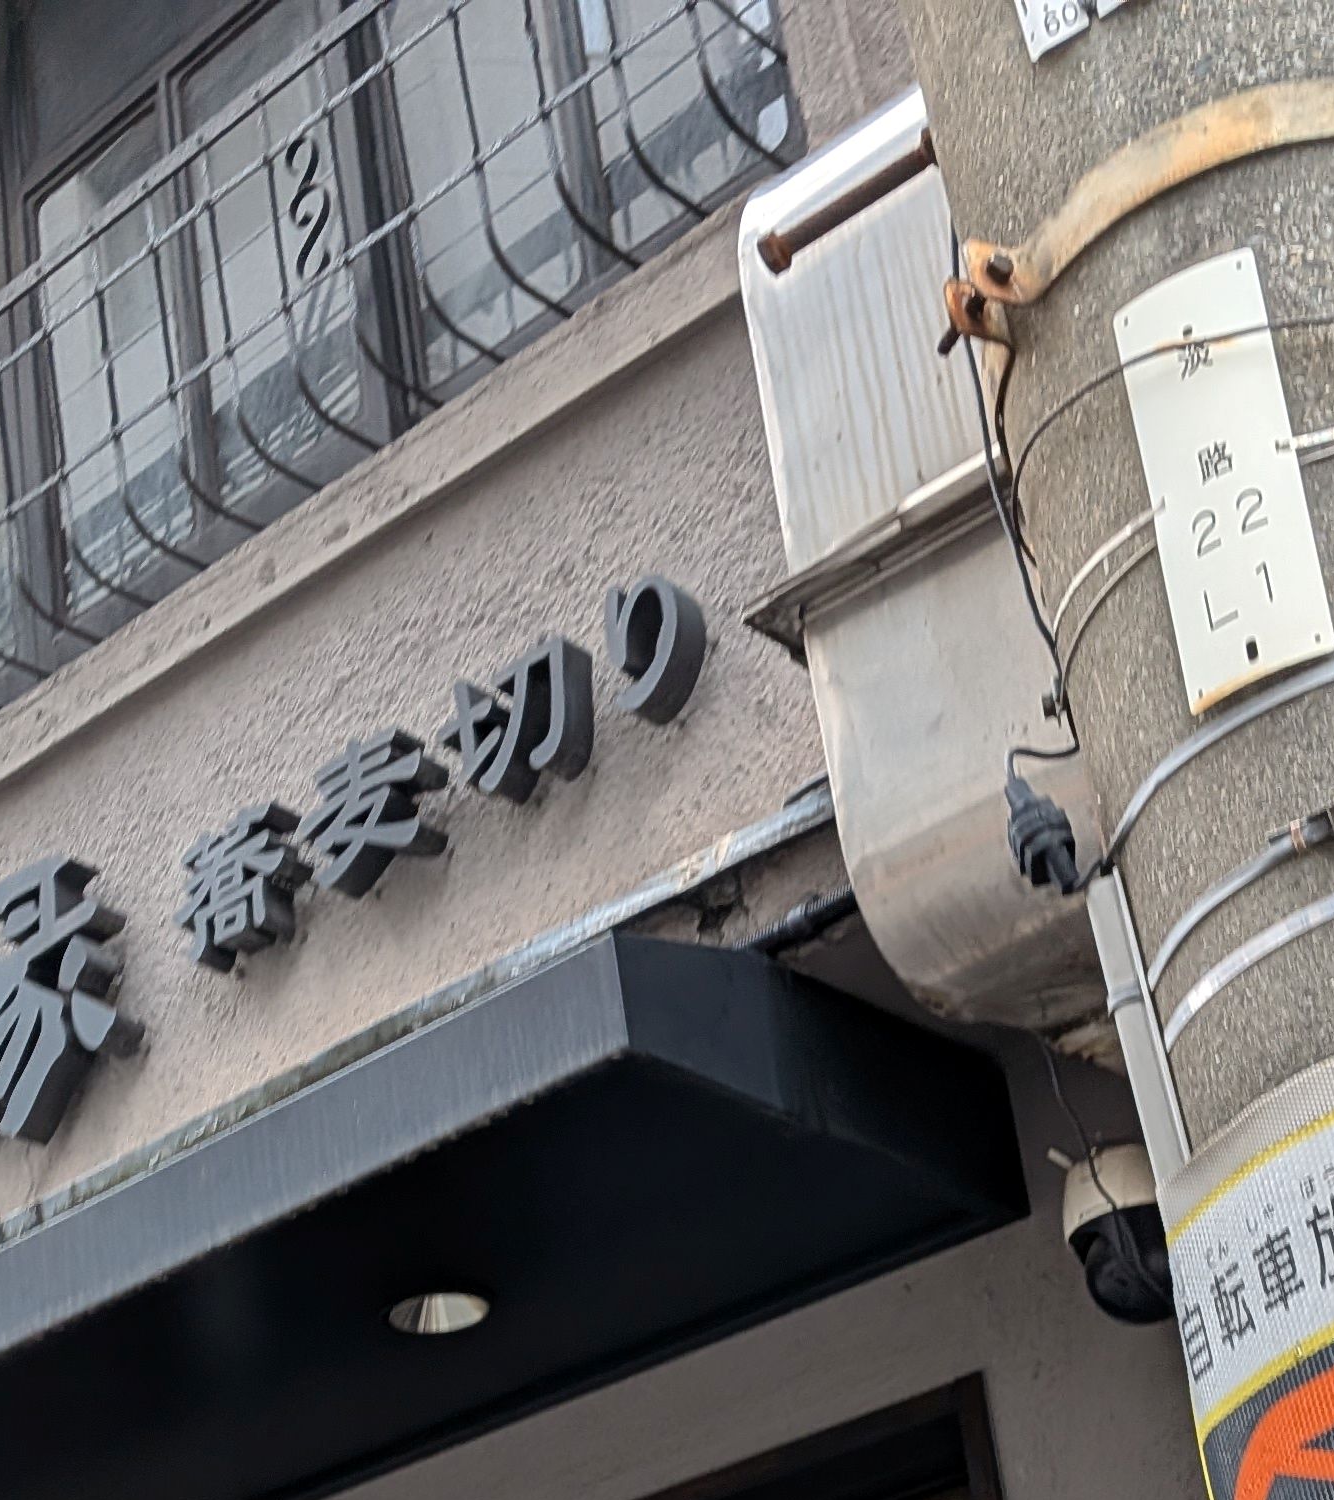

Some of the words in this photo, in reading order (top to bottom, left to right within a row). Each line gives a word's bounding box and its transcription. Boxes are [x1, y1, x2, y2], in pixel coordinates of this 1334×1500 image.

[1191, 486, 1269, 558] 22
[174, 572, 708, 972] 蕎麦切り
